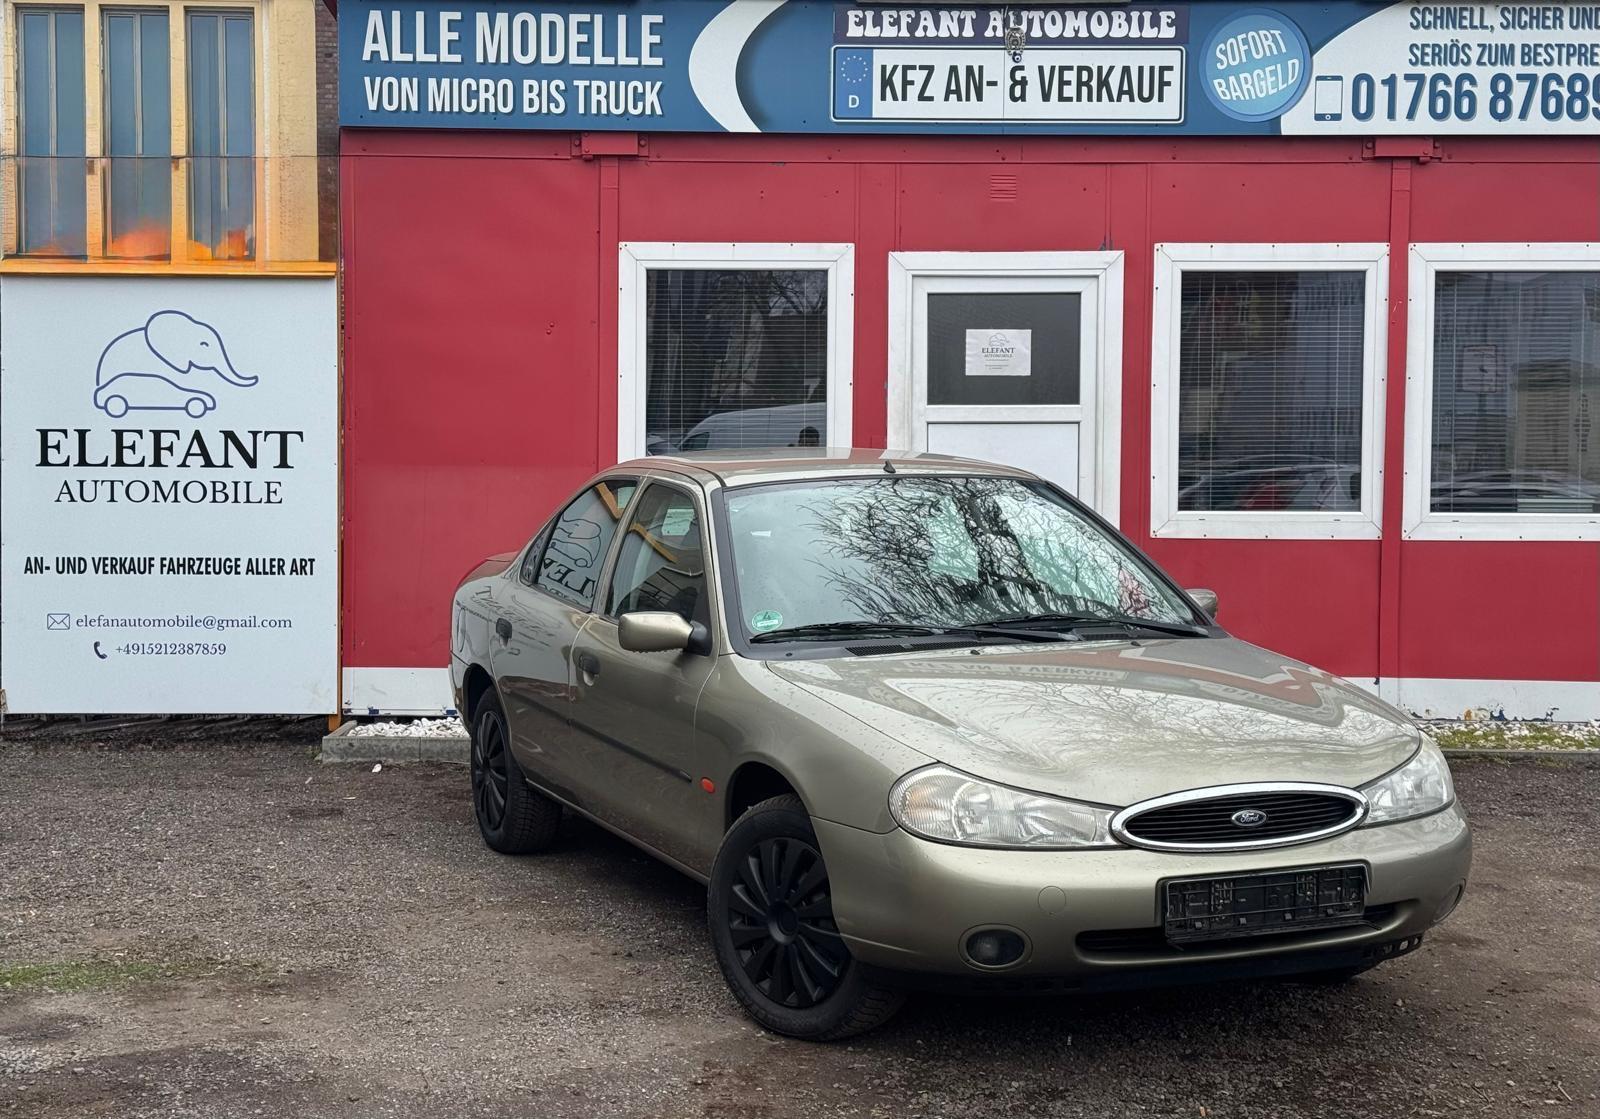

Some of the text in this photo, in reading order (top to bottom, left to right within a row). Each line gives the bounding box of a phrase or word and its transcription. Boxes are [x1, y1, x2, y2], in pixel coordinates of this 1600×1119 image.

[846, 10, 1176, 39] ELEFANT AUTOMOBILE
[1409, 6, 1495, 32] SCHNELL,
[1500, 6, 1564, 30] SICHER
[362, 10, 663, 66] ALLE MODELLE
[1215, 29, 1287, 70] SOFORT
[1408, 39, 1473, 67] SERIÖS
[1476, 43, 1515, 67] ZUM
[880, 64, 1174, 103] KFZ AN- & VERKAUF
[1213, 58, 1299, 100] BARGELD
[364, 76, 663, 116] VON MICRO BIS TRUCK
[848, 95, 860, 109] D
[1351, 72, 1478, 122] 01766
[35, 428, 304, 469] ELEFANT
[54, 479, 283, 504] AUTOMOBILE
[24, 557, 316, 576] AN- UND VERKAUF FAHRZEUGE ALLER ART
[76, 614, 292, 631] elefanautomobile@gmail.com
[115, 642, 227, 656] +4915212387859
[1240, 812, 1260, 823] Ford
